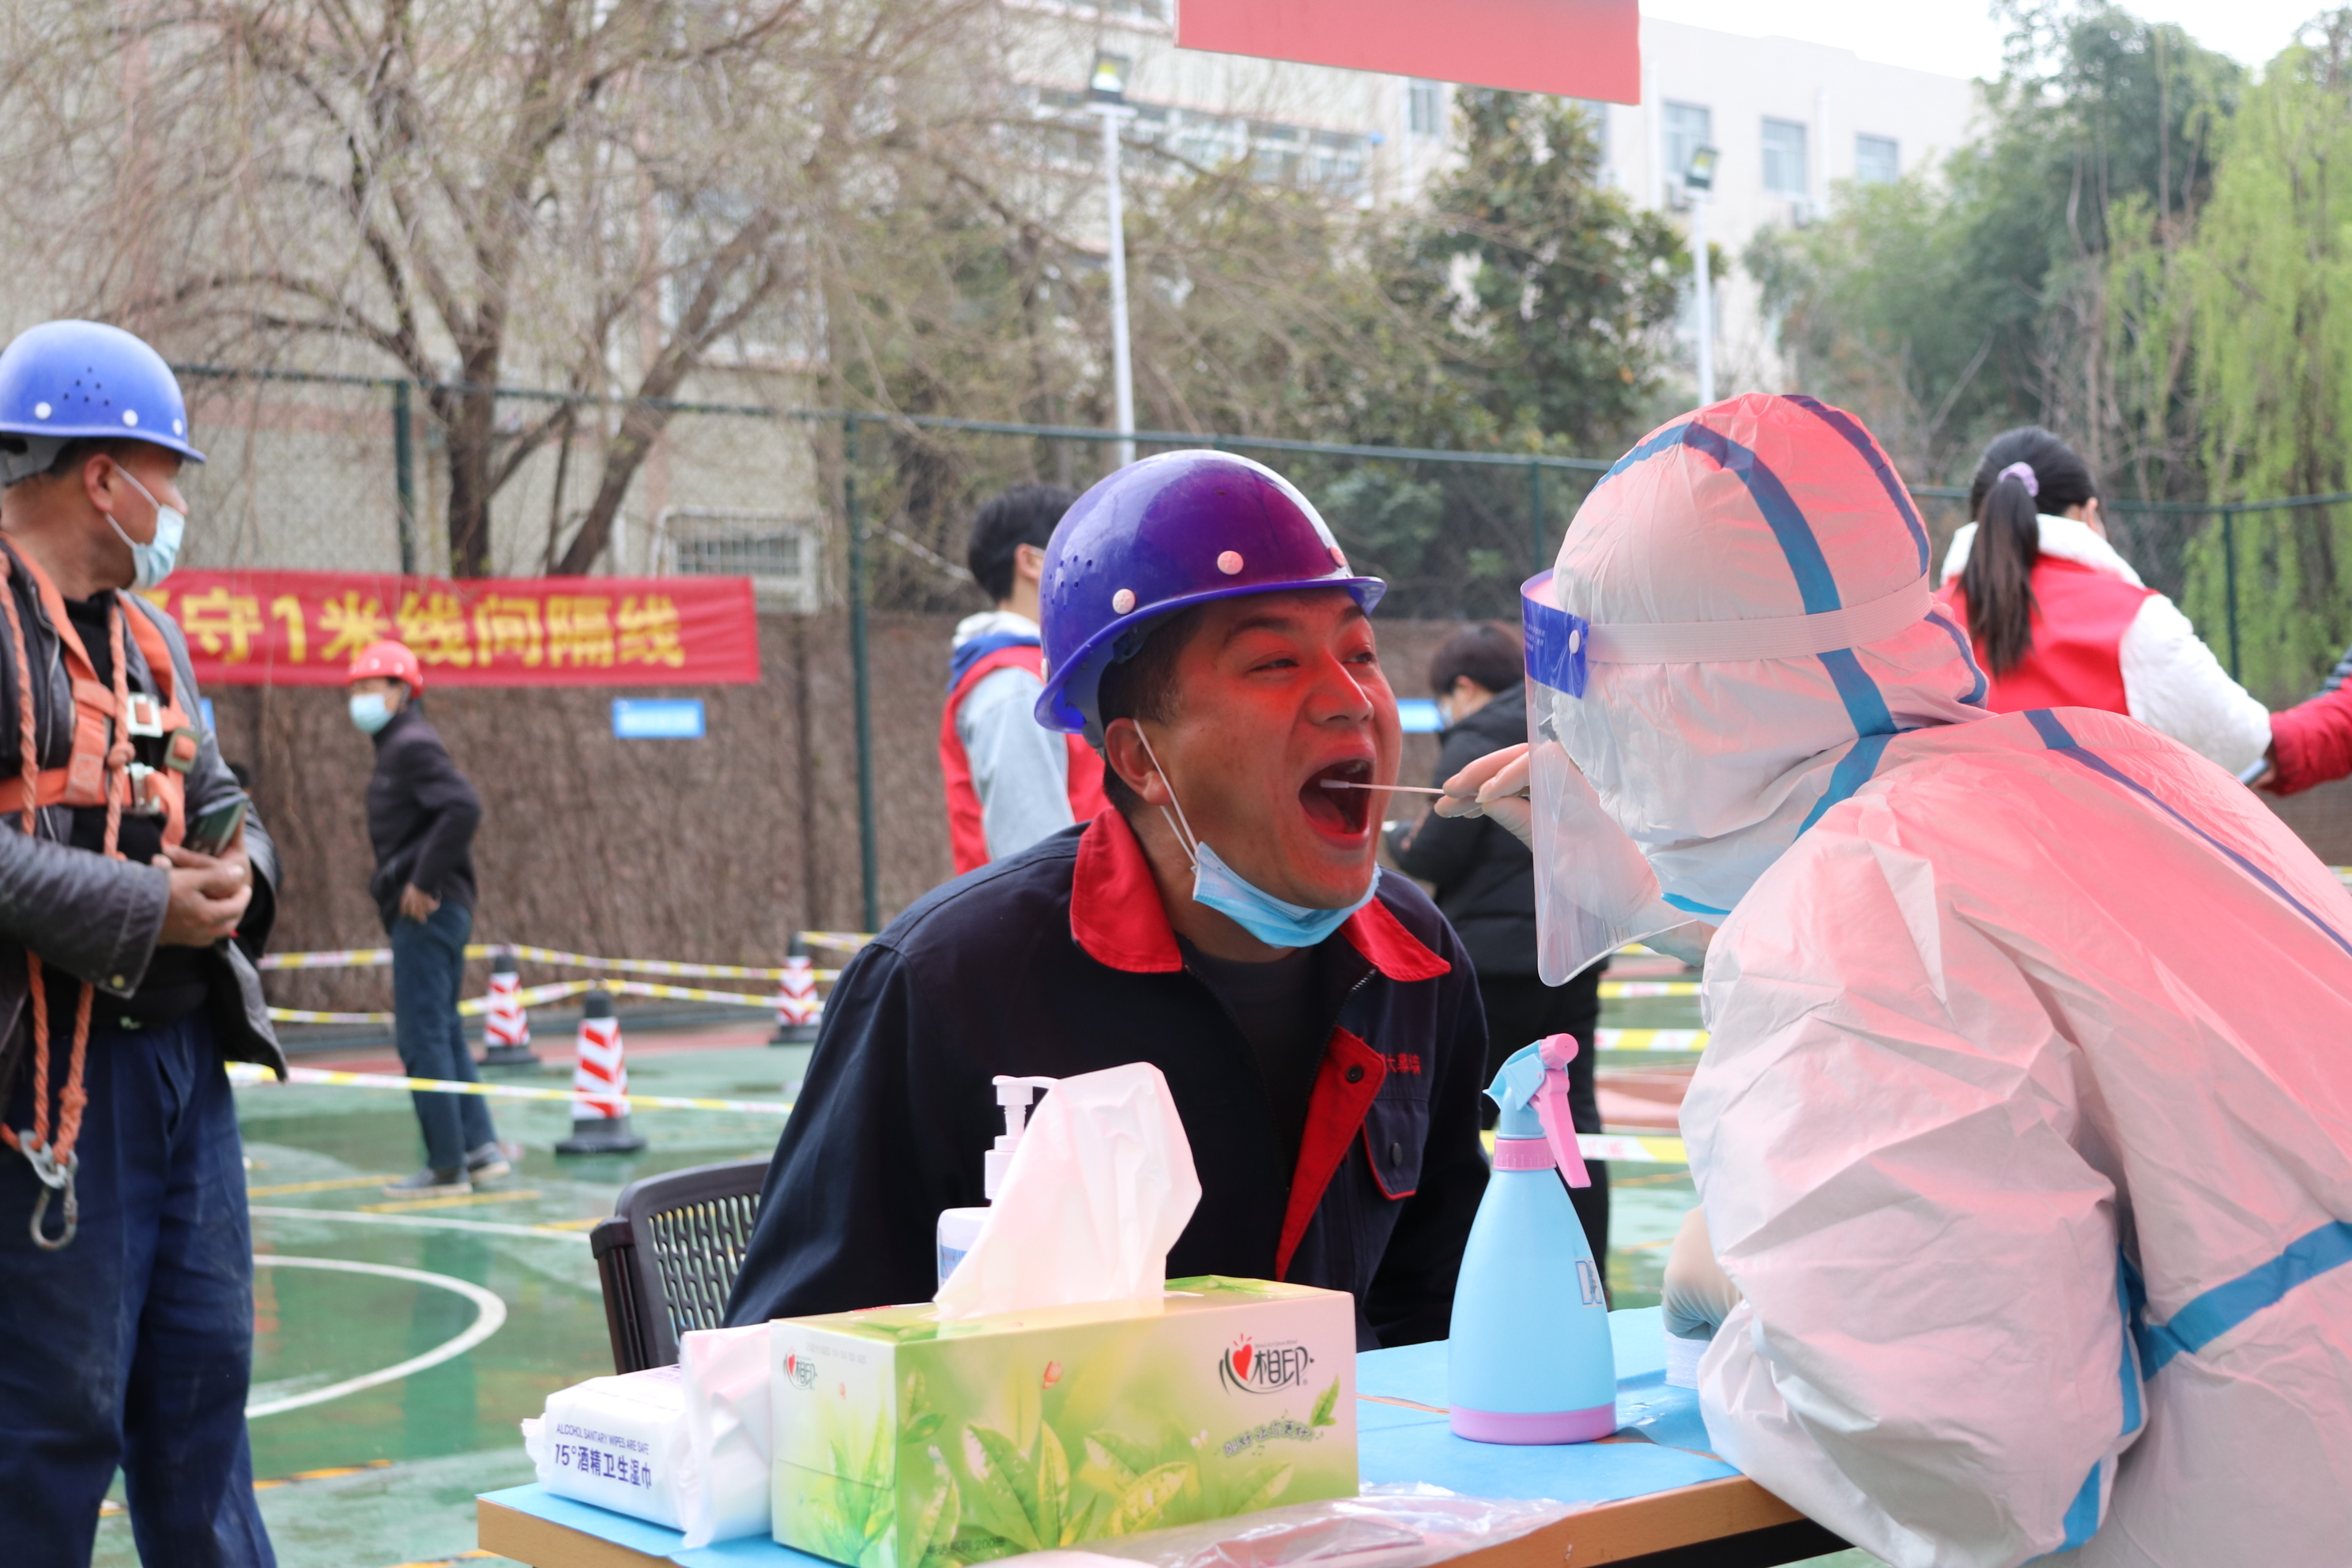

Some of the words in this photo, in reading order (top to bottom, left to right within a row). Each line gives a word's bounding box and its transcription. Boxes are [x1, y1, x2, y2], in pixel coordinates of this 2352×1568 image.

[136, 586, 686, 668] 守1米线间隔线
[556, 1423, 583, 1438] ALCOHOL
[583, 1428, 608, 1445] SANITARY
[608, 1434, 626, 1449] WIPES
[626, 1439, 637, 1452] ARE
